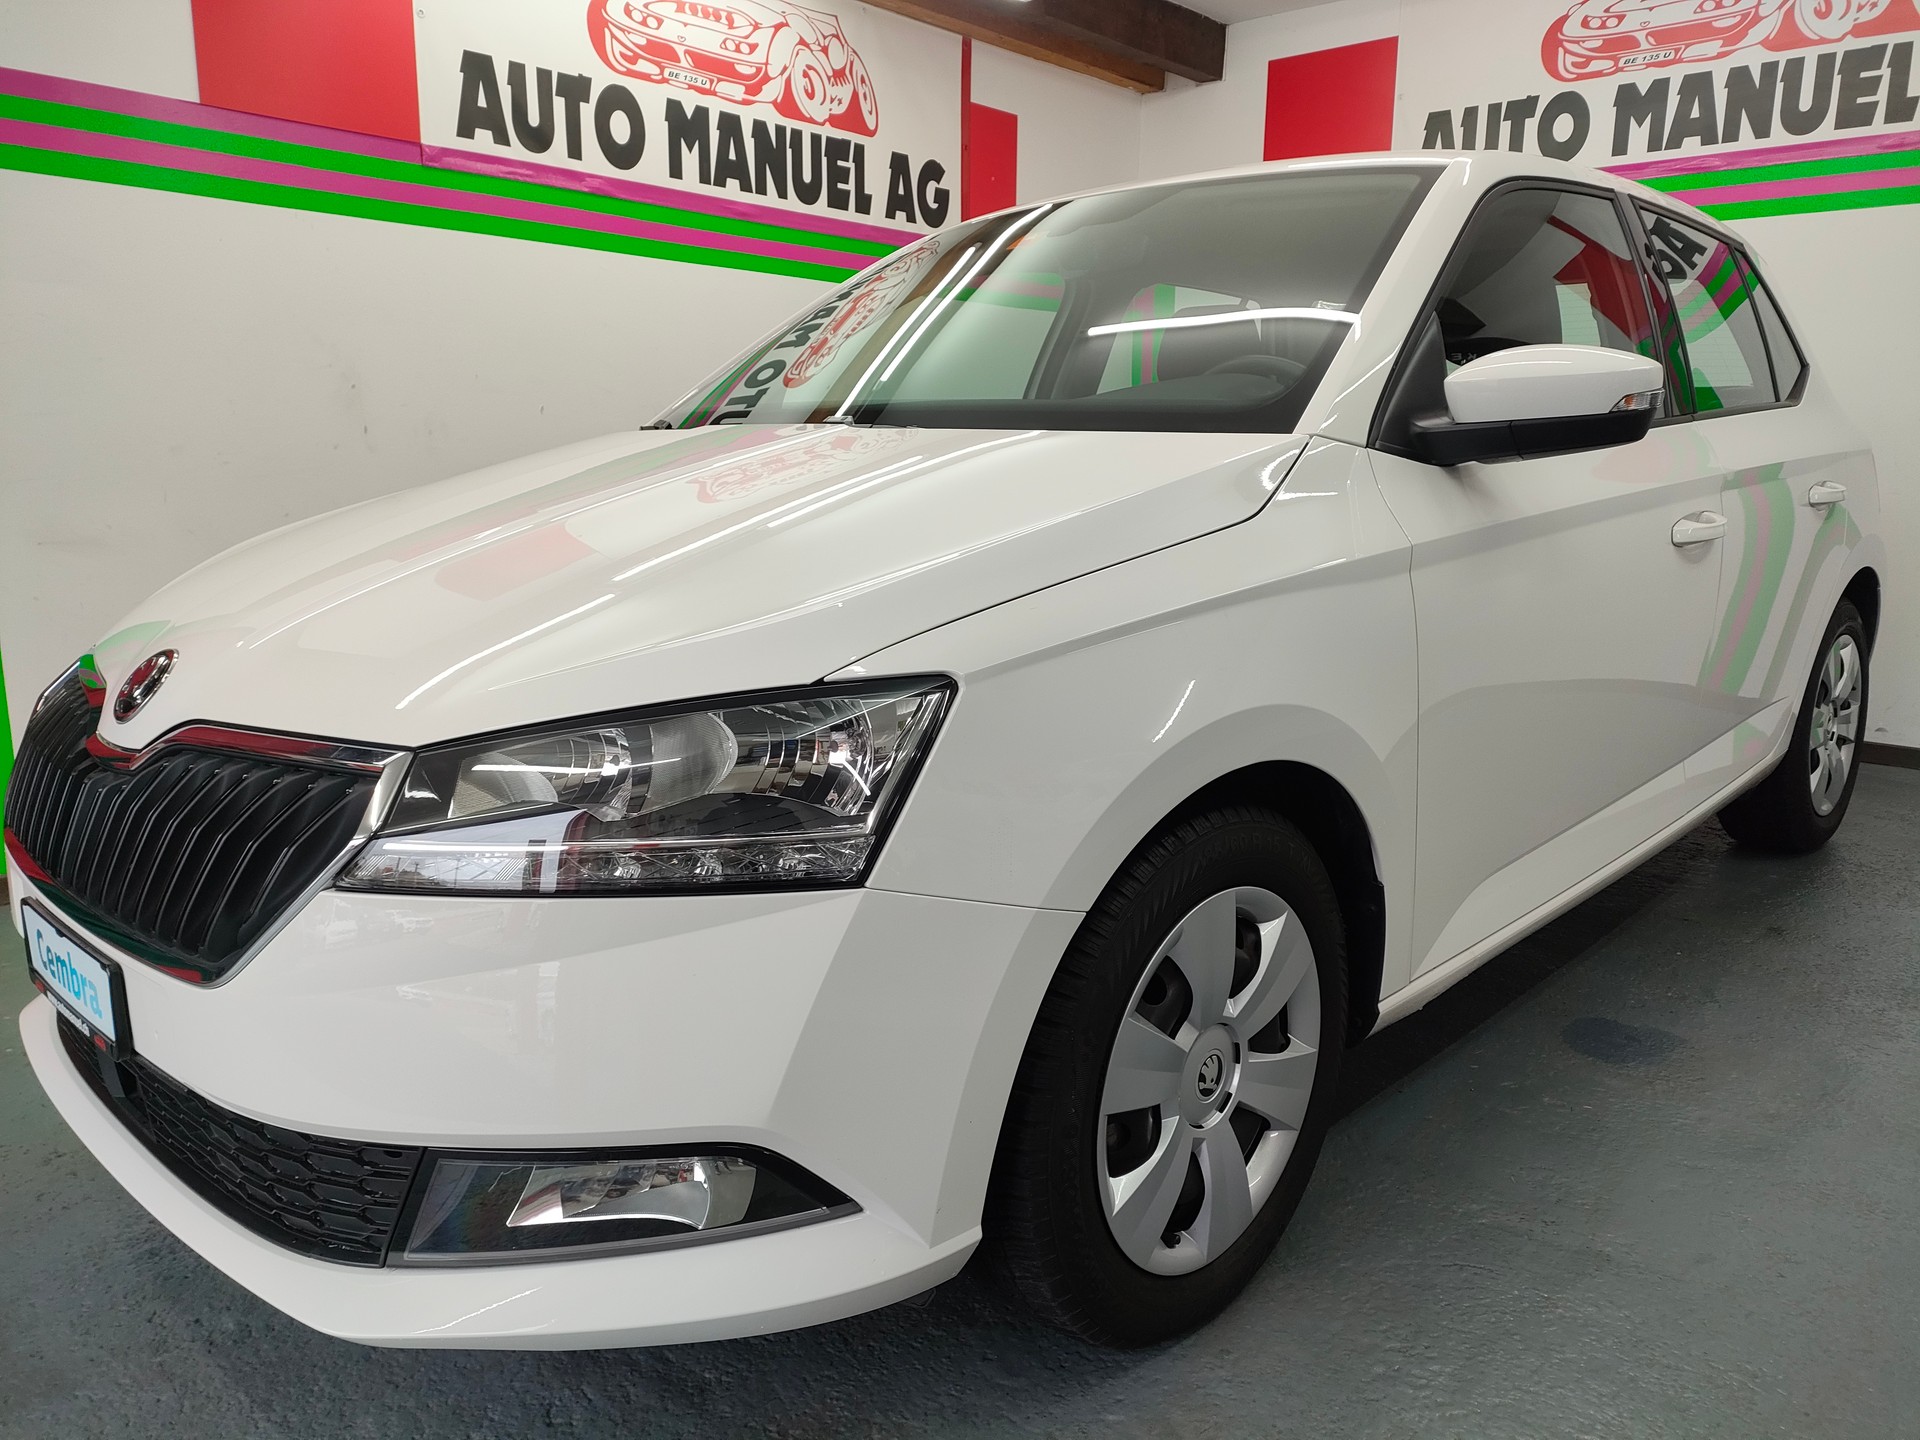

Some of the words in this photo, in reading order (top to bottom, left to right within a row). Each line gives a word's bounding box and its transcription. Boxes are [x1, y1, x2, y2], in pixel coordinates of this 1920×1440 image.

[668, 70, 681, 79] BE
[683, 74, 699, 84] 135
[1422, 90, 1591, 162] AUTO
[1611, 40, 1920, 157] MANUEL
[1623, 56, 1639, 65] BE
[1641, 52, 1662, 62] 135
[1663, 51, 1672, 59] U
[456, 49, 646, 171] AUTO
[664, 97, 873, 216] MANUEL
[885, 150, 951, 229] AG
[36, 928, 103, 1019] Cembra
